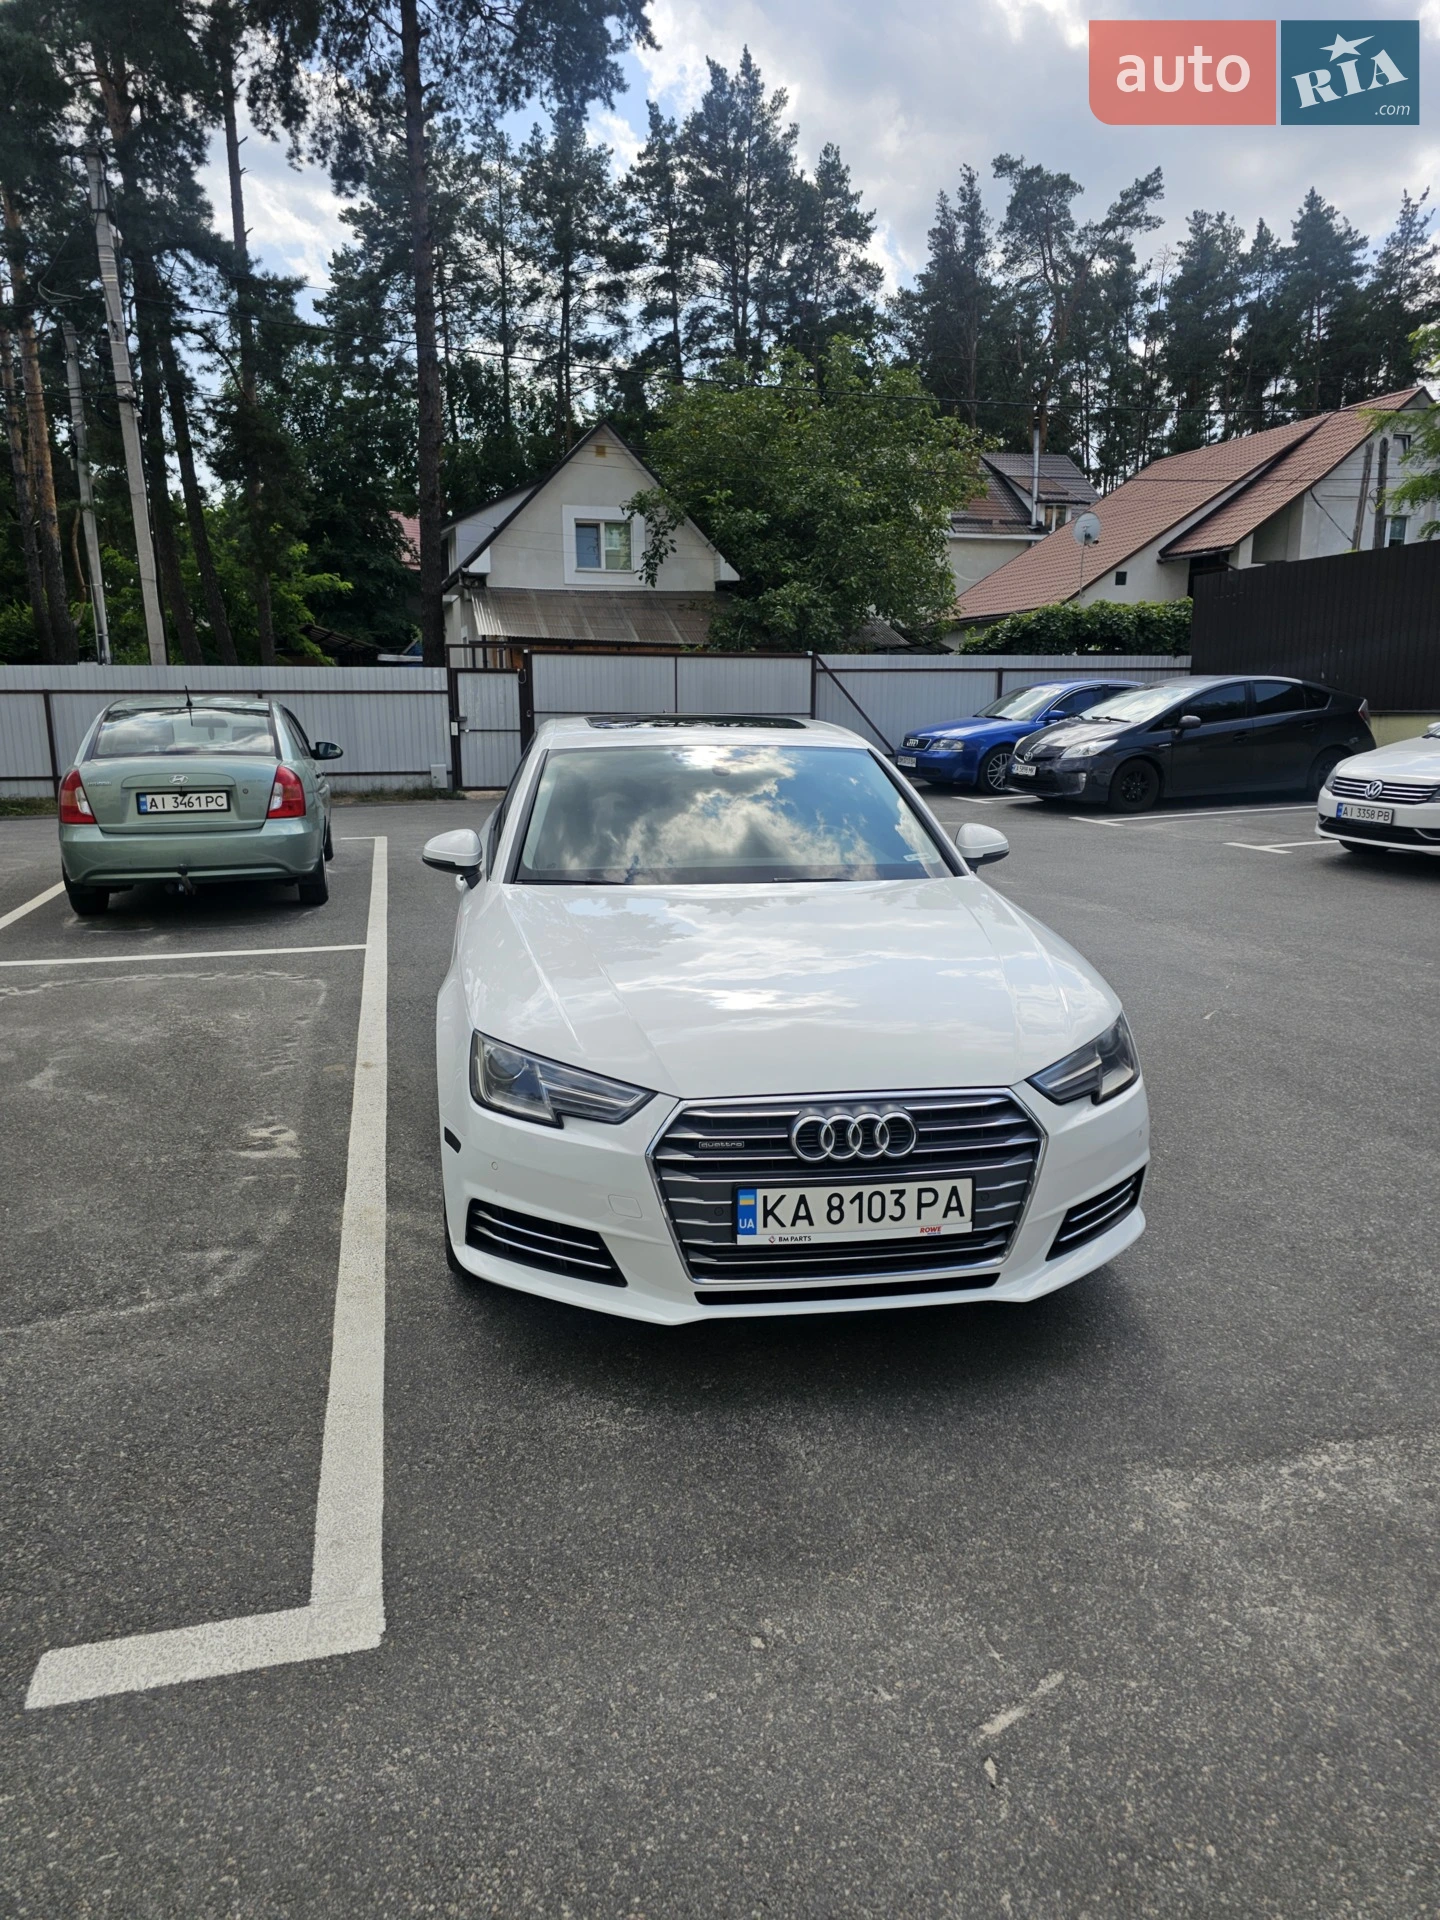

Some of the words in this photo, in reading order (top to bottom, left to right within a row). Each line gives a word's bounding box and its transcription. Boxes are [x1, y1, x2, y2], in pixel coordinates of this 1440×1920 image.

[1356, 808, 1376, 820] 3358
[1376, 810, 1390, 821] PB
[762, 1194, 815, 1229] KA
[826, 1188, 907, 1225] 8103
[916, 1185, 966, 1221] PA
[739, 1218, 755, 1229] UA
[919, 1225, 943, 1233] ROWE
